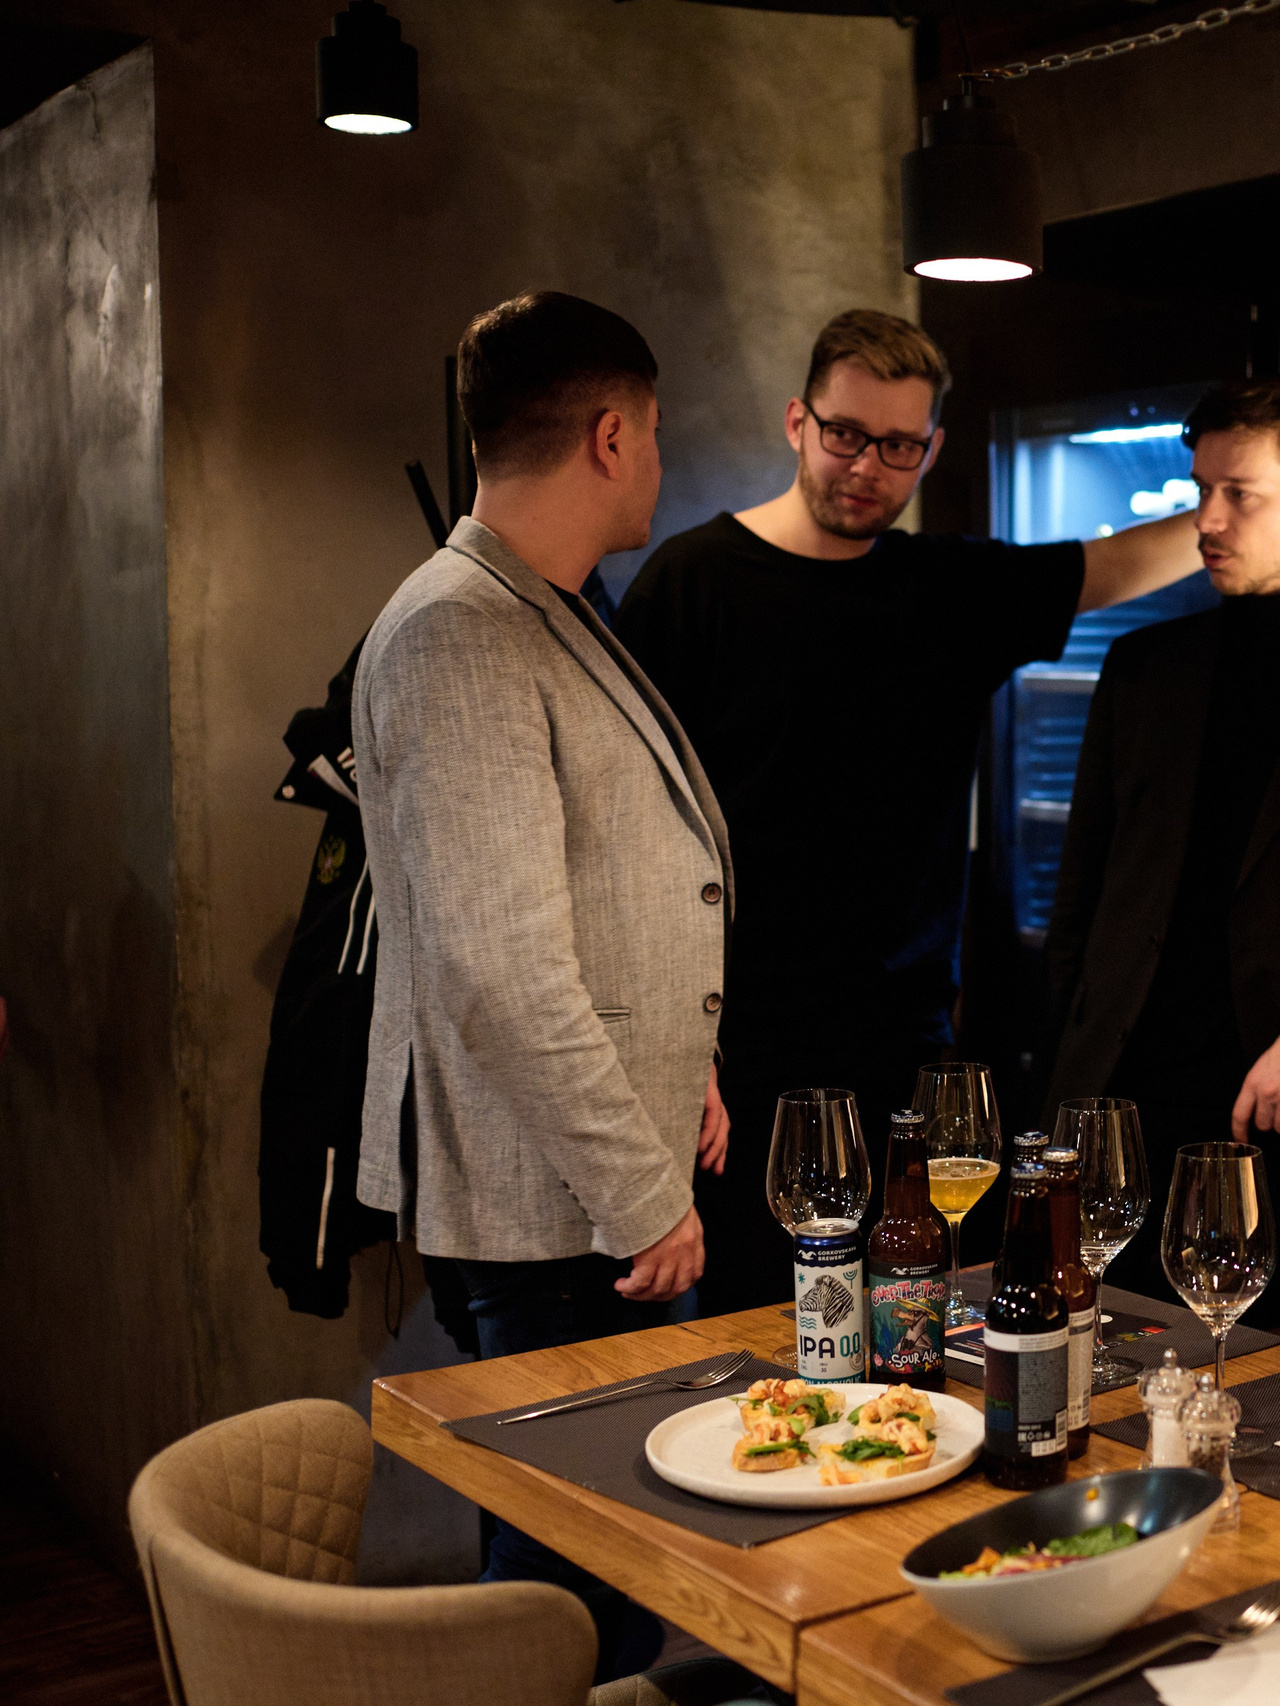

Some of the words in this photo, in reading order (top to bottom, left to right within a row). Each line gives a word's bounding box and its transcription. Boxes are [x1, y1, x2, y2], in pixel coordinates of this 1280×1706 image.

[817, 1254, 846, 1262] BREWERY
[800, 1335, 835, 1358] IPA
[840, 1332, 860, 1358] 0,0
